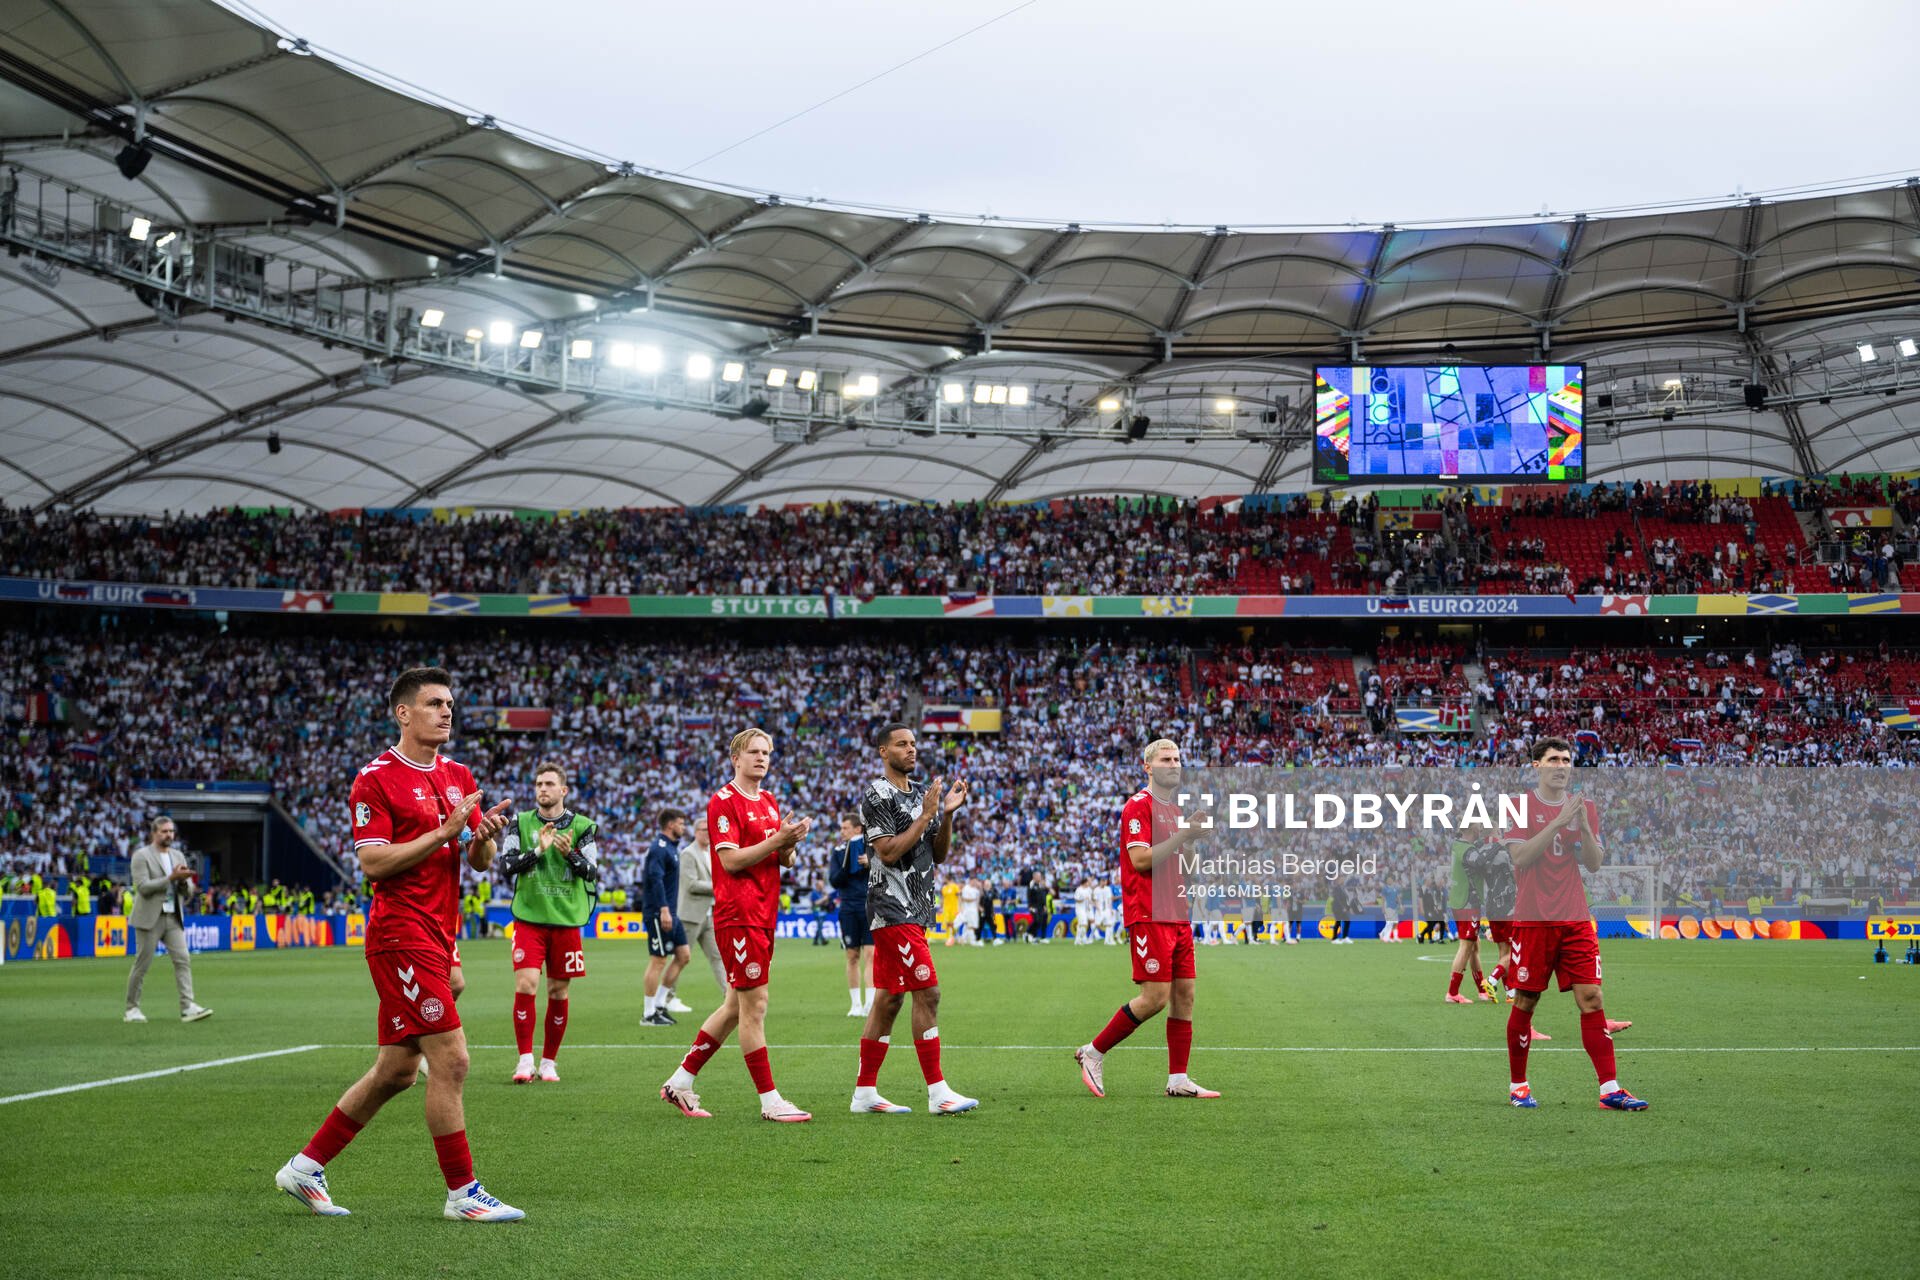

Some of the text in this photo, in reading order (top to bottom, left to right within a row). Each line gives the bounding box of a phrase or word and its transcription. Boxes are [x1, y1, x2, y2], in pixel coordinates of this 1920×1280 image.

[711, 599, 862, 614] STUTTGART
[1553, 832, 1563, 856] 6
[565, 951, 584, 972] 26
